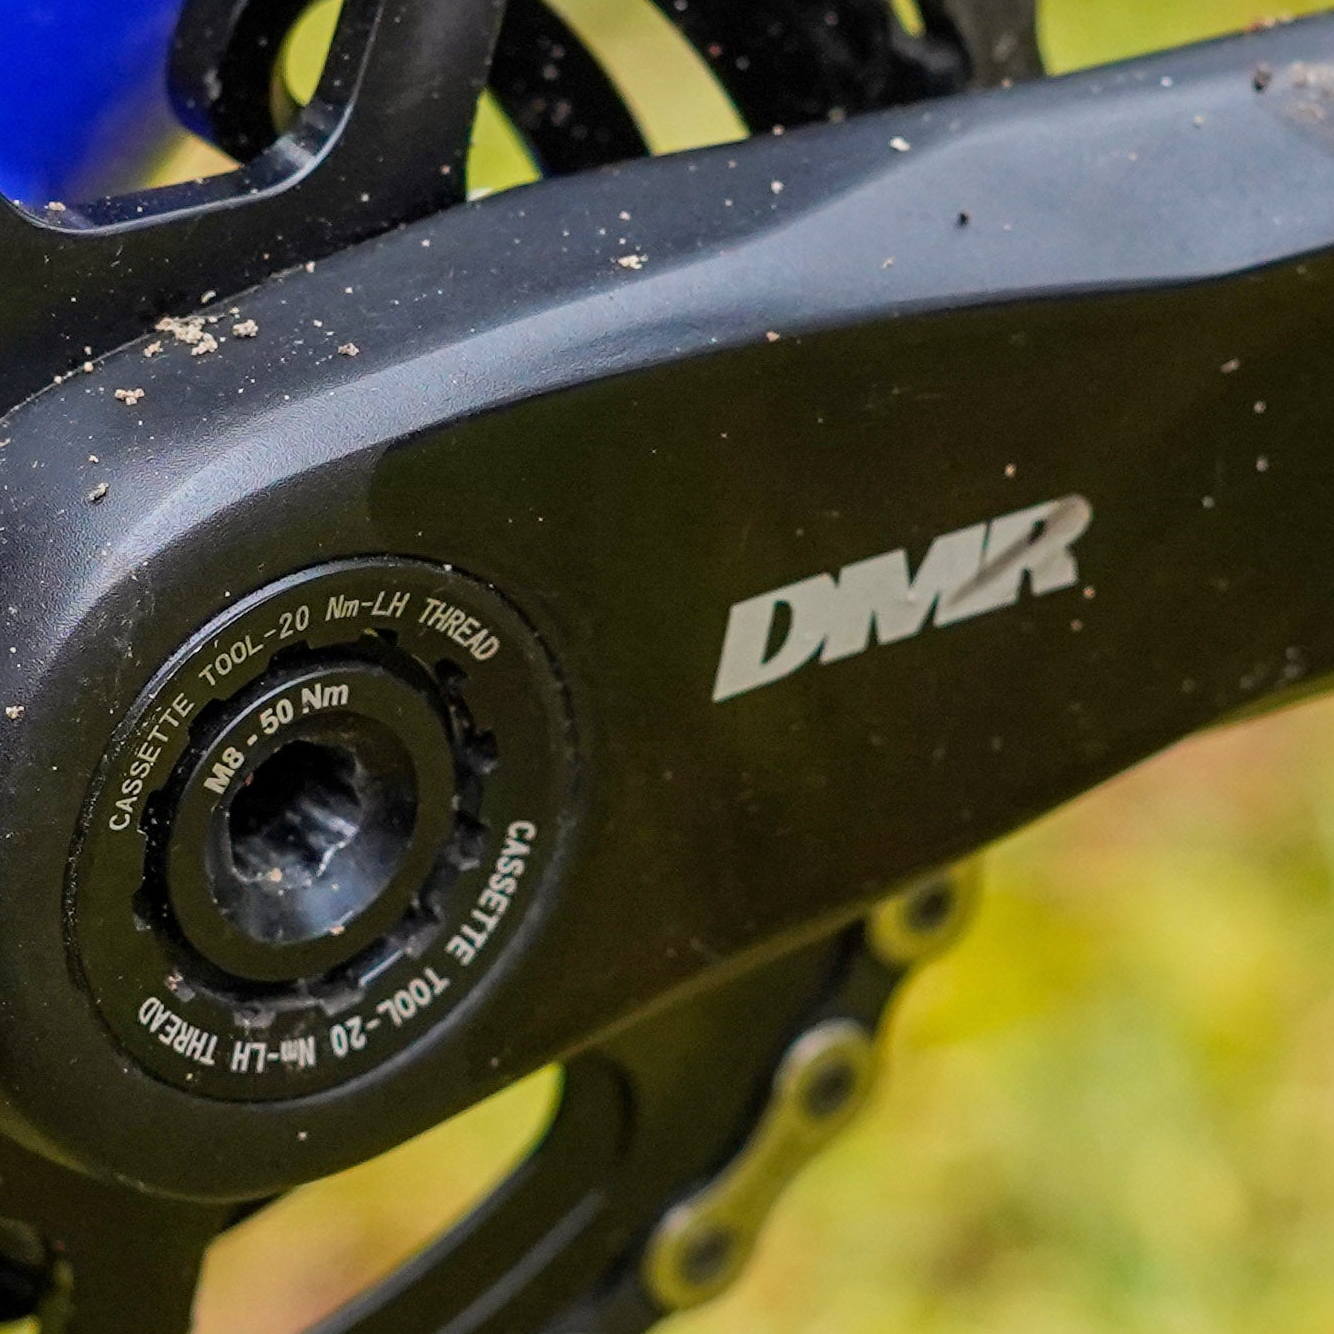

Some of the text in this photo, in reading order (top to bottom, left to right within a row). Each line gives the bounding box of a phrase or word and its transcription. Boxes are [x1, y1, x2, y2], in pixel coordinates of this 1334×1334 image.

[712, 493, 1093, 704] DMR
[108, 692, 195, 833] CASSETTE
[417, 598, 501, 663] THREAD
[203, 744, 246, 796] M8
[259, 698, 295, 736] 50
[300, 682, 349, 715] Nm
[446, 819, 537, 964] CASSETTE
[138, 995, 219, 1067] THREAD
